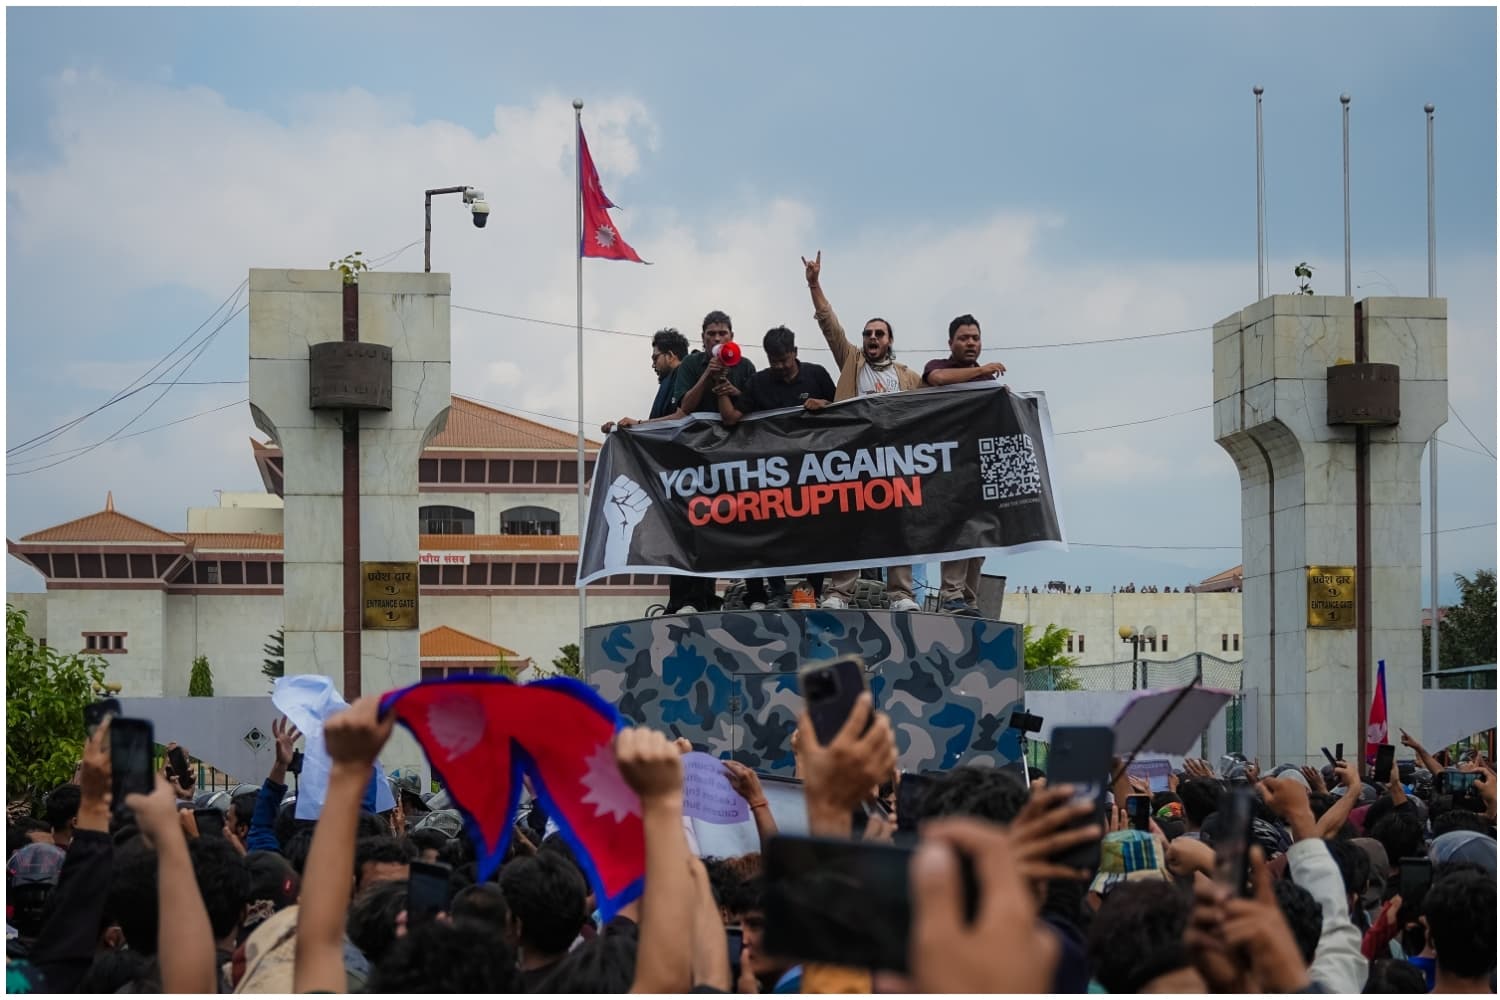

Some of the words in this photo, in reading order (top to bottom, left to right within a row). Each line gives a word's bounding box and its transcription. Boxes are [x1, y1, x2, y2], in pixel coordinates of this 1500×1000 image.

[659, 456, 789, 499] YOUTHS
[797, 441, 958, 485] AGAINST
[688, 476, 922, 527] CORRUPTION
[367, 599, 398, 608] ENTRANCE
[399, 599, 415, 608] GATE
[1311, 600, 1339, 609] ENTRANCE
[1340, 600, 1353, 609] GATE
